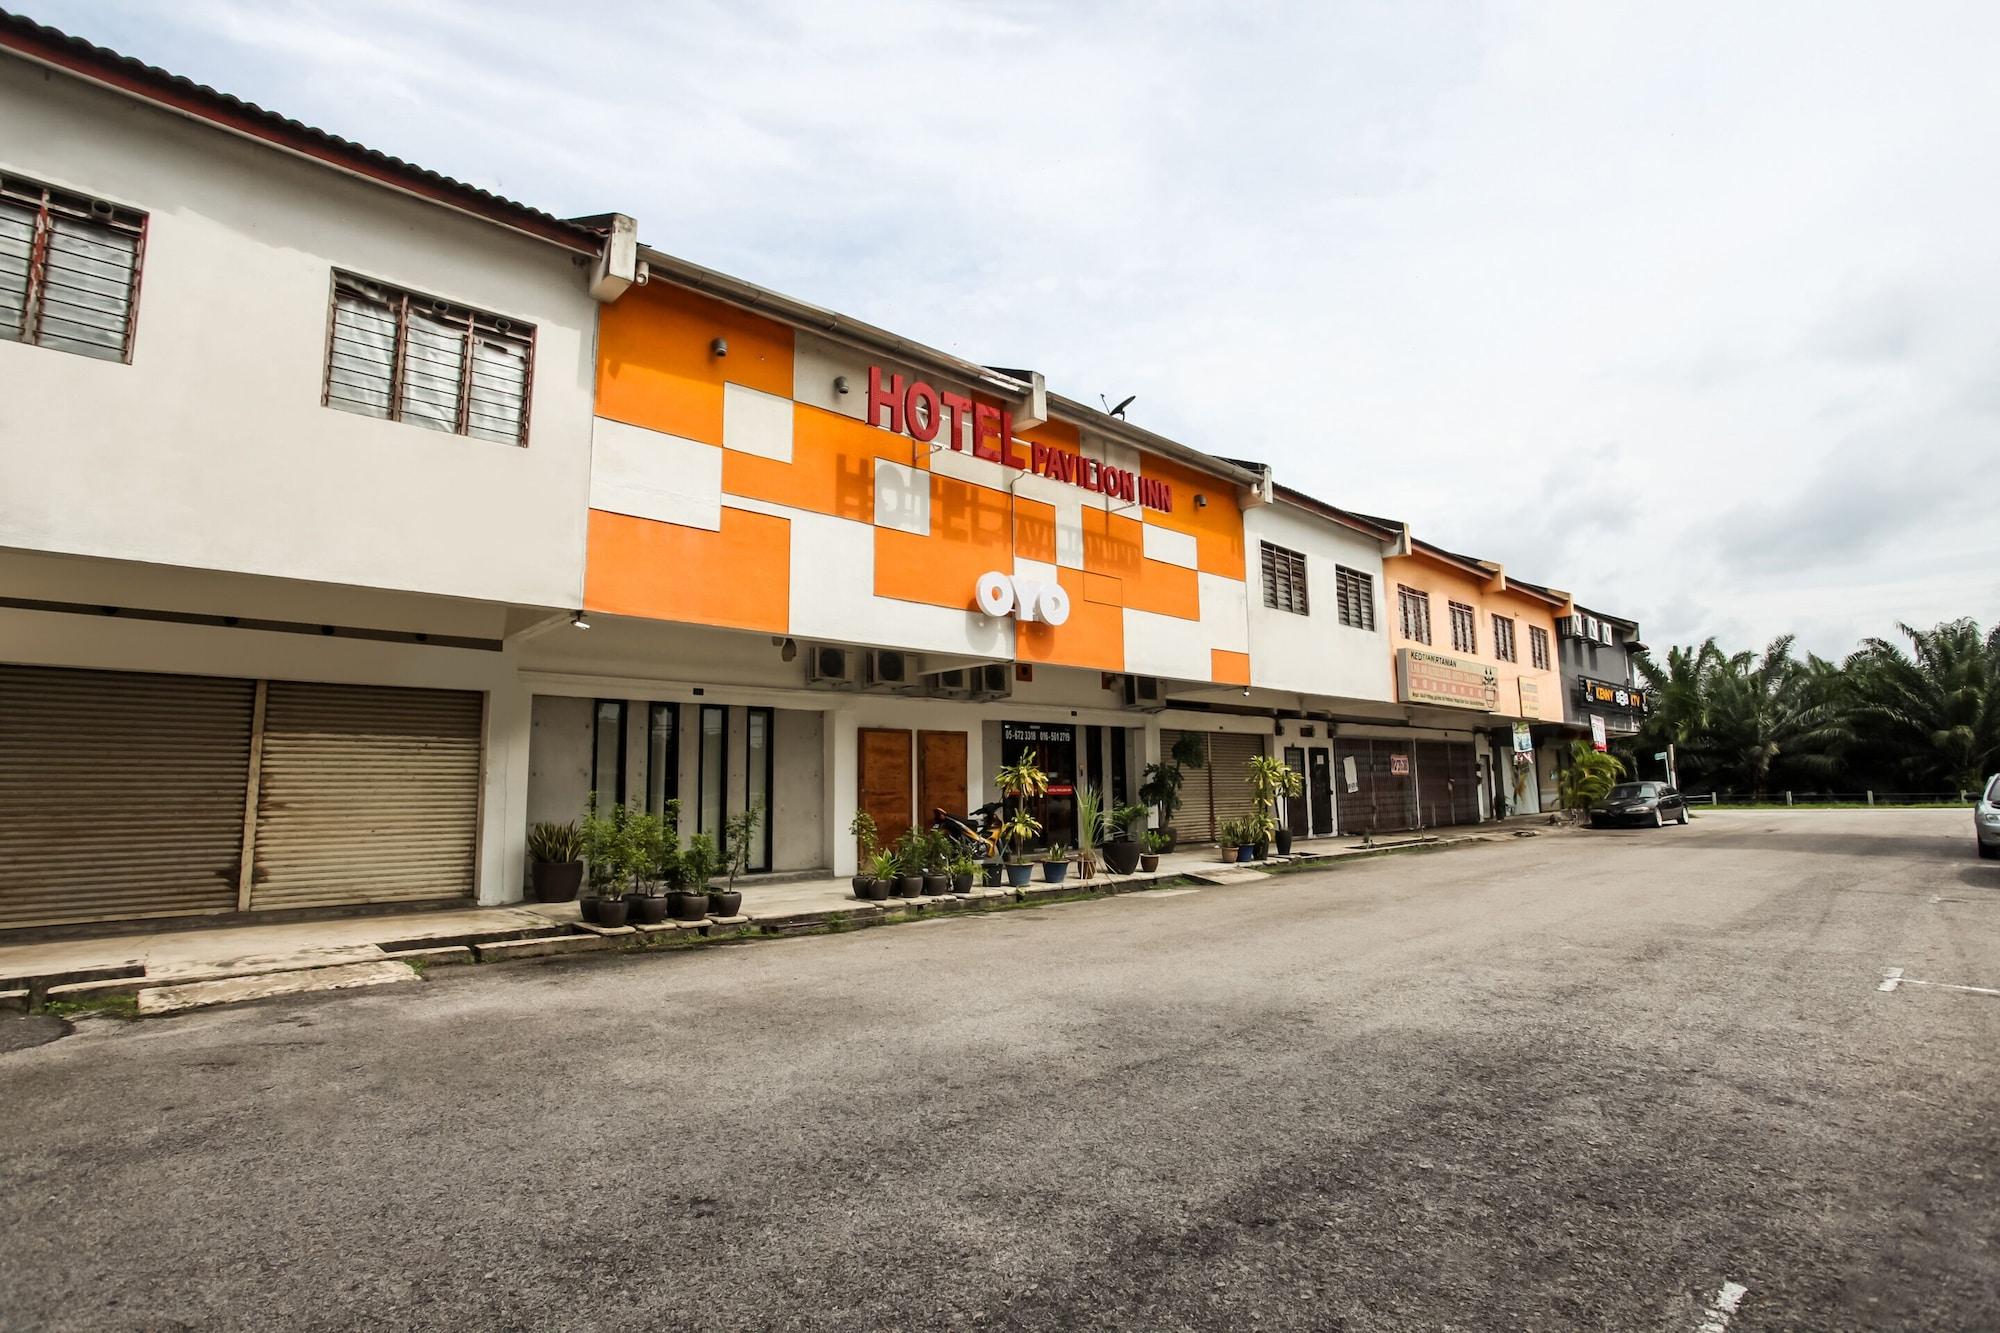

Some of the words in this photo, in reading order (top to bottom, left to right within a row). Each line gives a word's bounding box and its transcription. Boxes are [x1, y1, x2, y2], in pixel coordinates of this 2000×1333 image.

[868, 366, 1025, 470] HOTEL
[1031, 441, 1135, 502] PAVILION
[1138, 476, 1173, 513] INN
[976, 571, 1070, 626] OYO
[1596, 686, 1614, 702] KENNY
